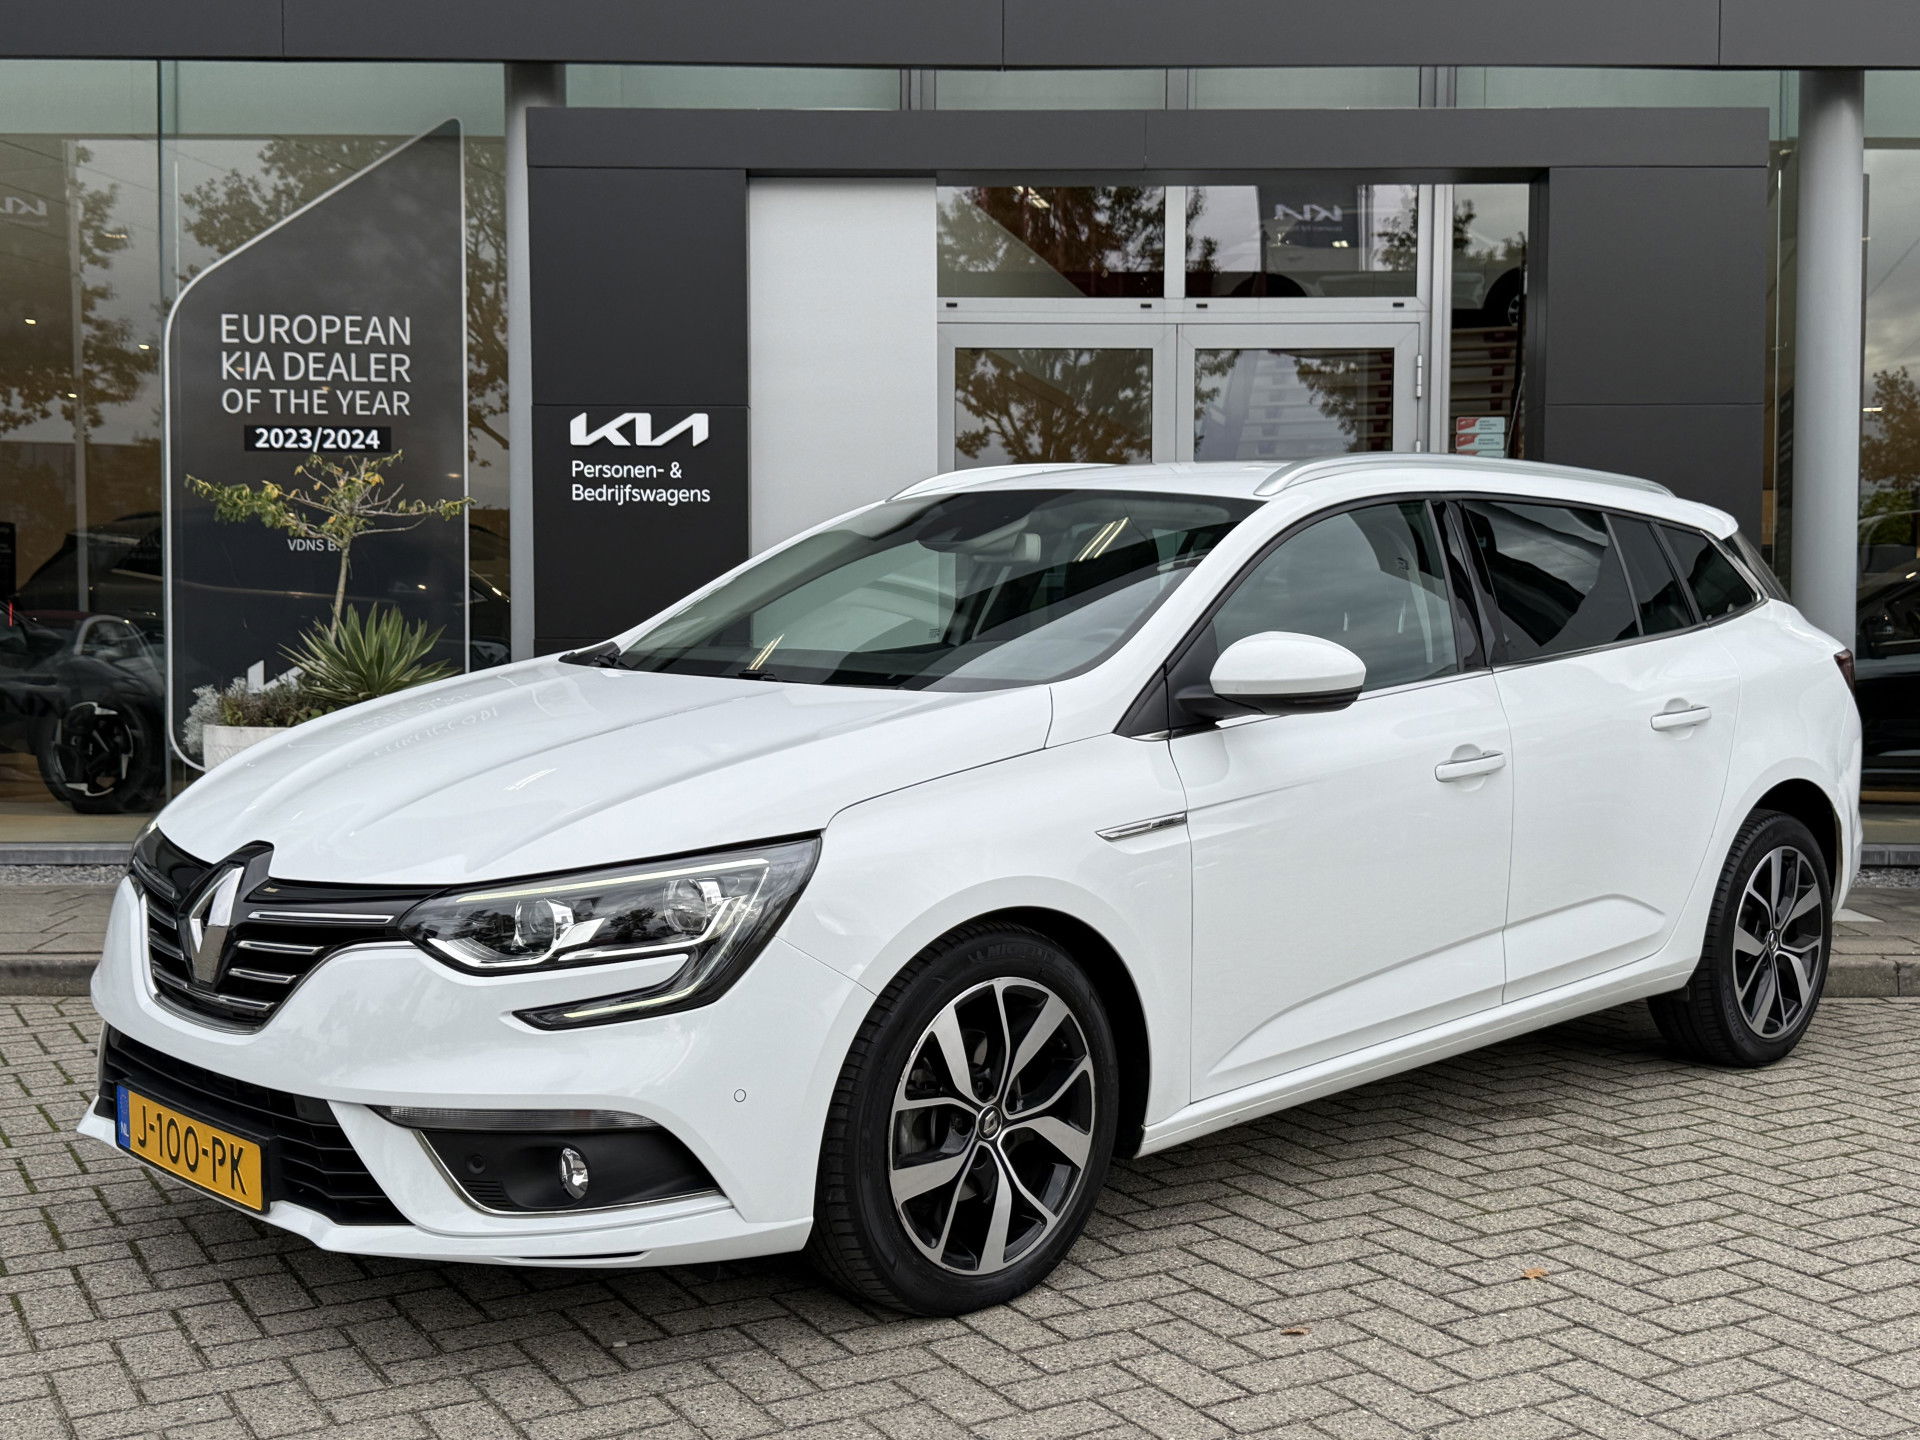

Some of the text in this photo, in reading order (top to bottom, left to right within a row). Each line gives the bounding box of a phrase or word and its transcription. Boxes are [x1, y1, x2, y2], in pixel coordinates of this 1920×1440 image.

[220, 313, 411, 346] EUROPEAN
[221, 351, 411, 383] KIA DEALER
[221, 388, 411, 416] OF THE YEAR
[254, 427, 381, 452] 2023/2024
[570, 412, 709, 447] KIA
[571, 460, 682, 479] Personen- &
[571, 484, 711, 506] Bedrijfswagens
[287, 538, 325, 552] VDNS
[120, 1121, 129, 1137] NL
[137, 1105, 247, 1195] J-100-PK
